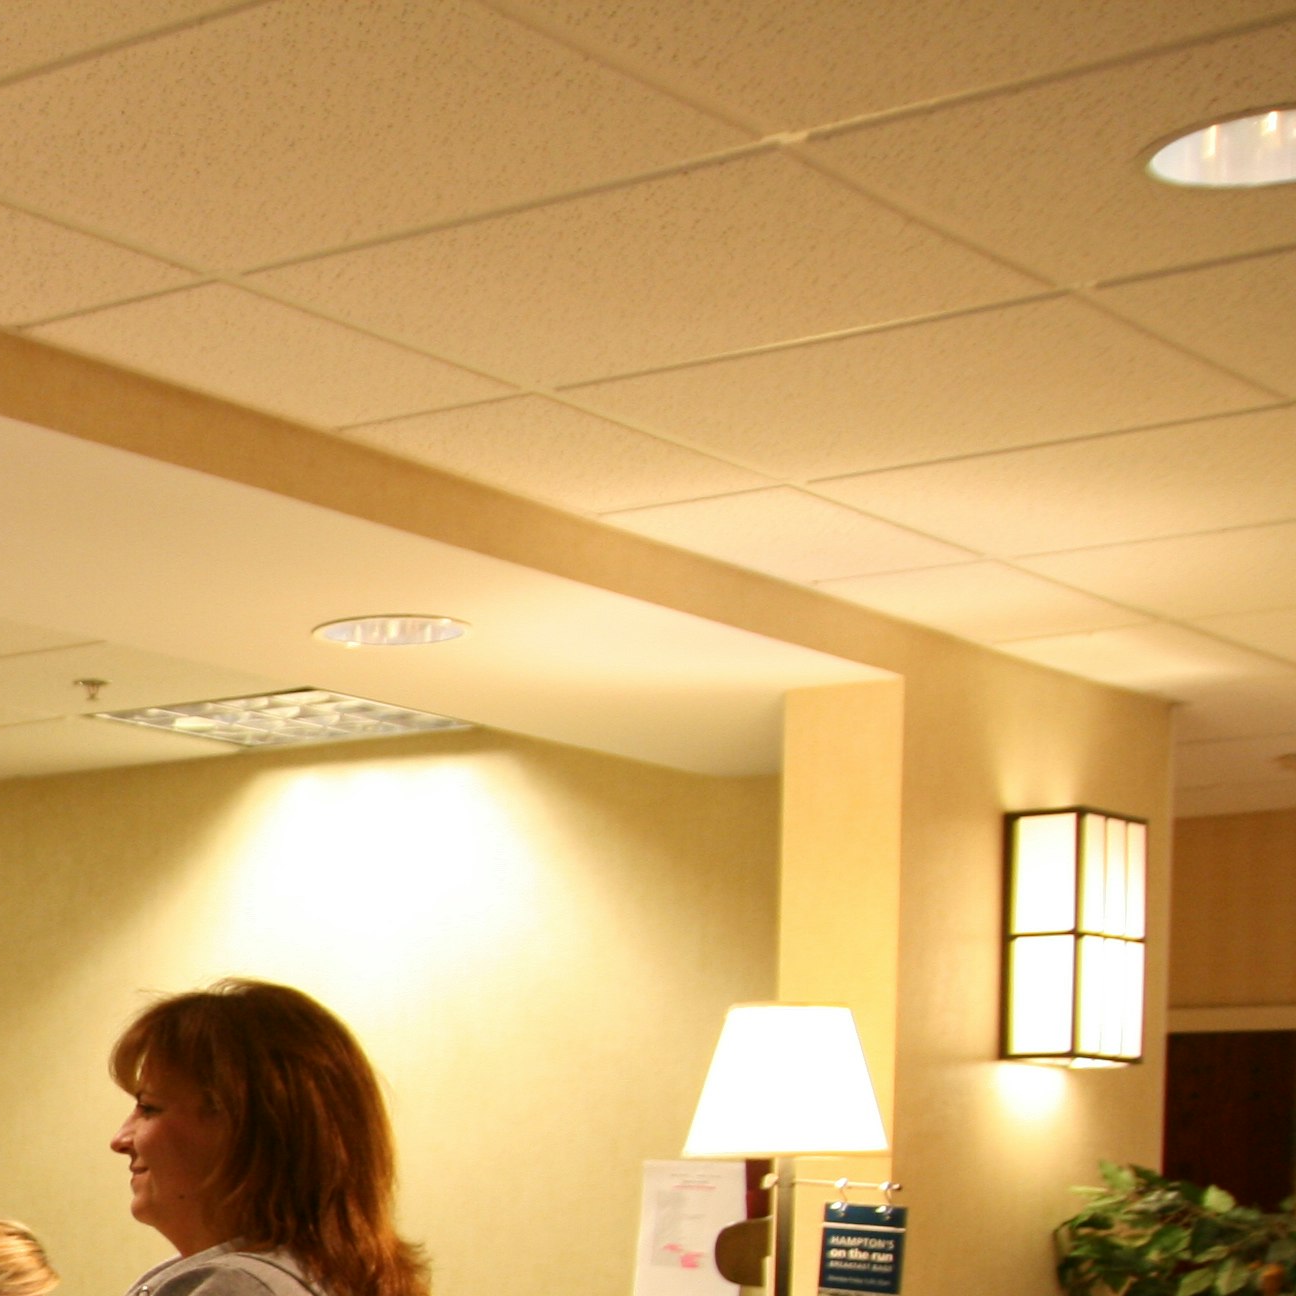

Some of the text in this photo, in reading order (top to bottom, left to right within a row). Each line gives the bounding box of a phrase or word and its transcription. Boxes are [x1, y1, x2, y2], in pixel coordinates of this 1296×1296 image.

[829, 1236, 895, 1250] HAMPTON'S
[829, 1248, 894, 1263] on the run
